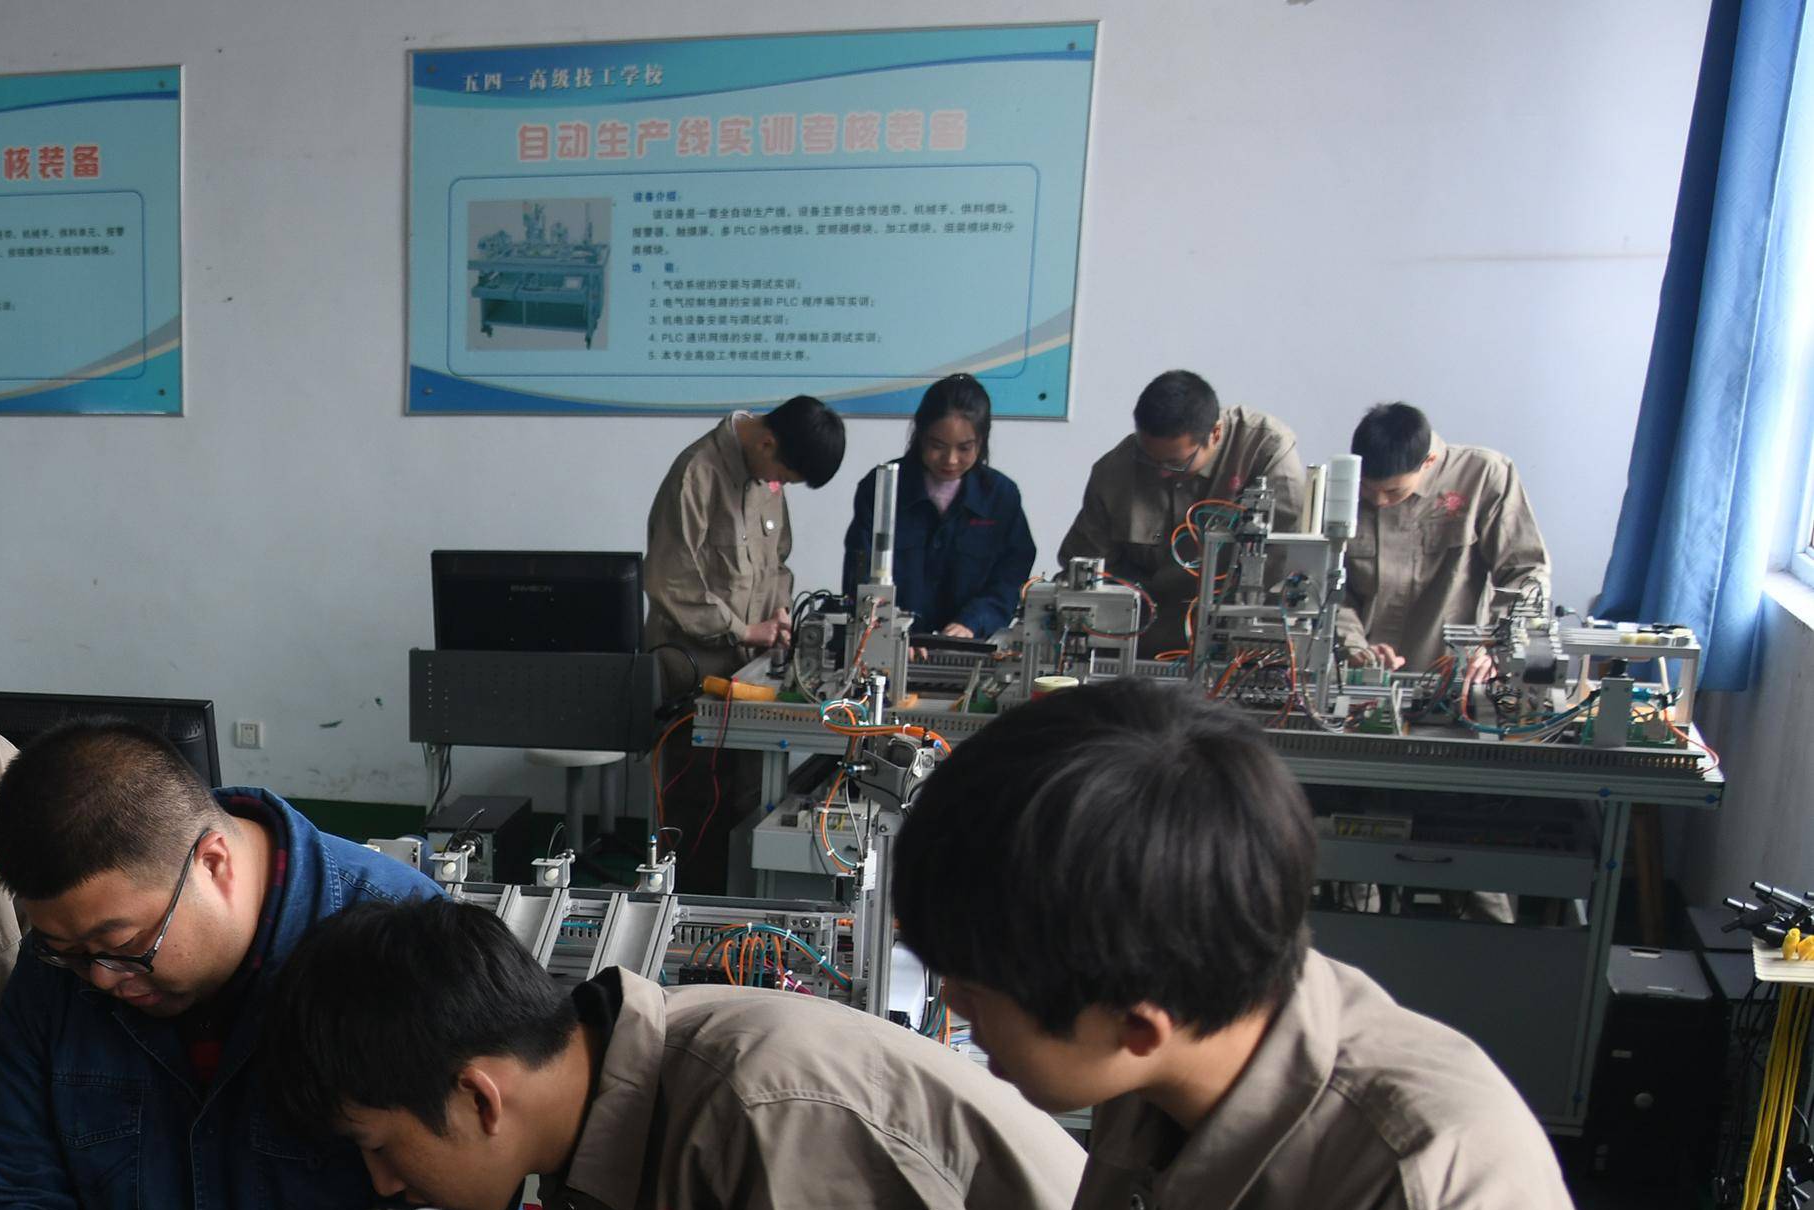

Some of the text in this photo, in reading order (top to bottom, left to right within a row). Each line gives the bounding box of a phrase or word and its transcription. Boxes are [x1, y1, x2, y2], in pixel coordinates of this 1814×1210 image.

[461, 62, 665, 94] 五四一高级技工学校
[517, 108, 969, 164] 自动生产线实训考核装备
[775, 296, 798, 308] PLC
